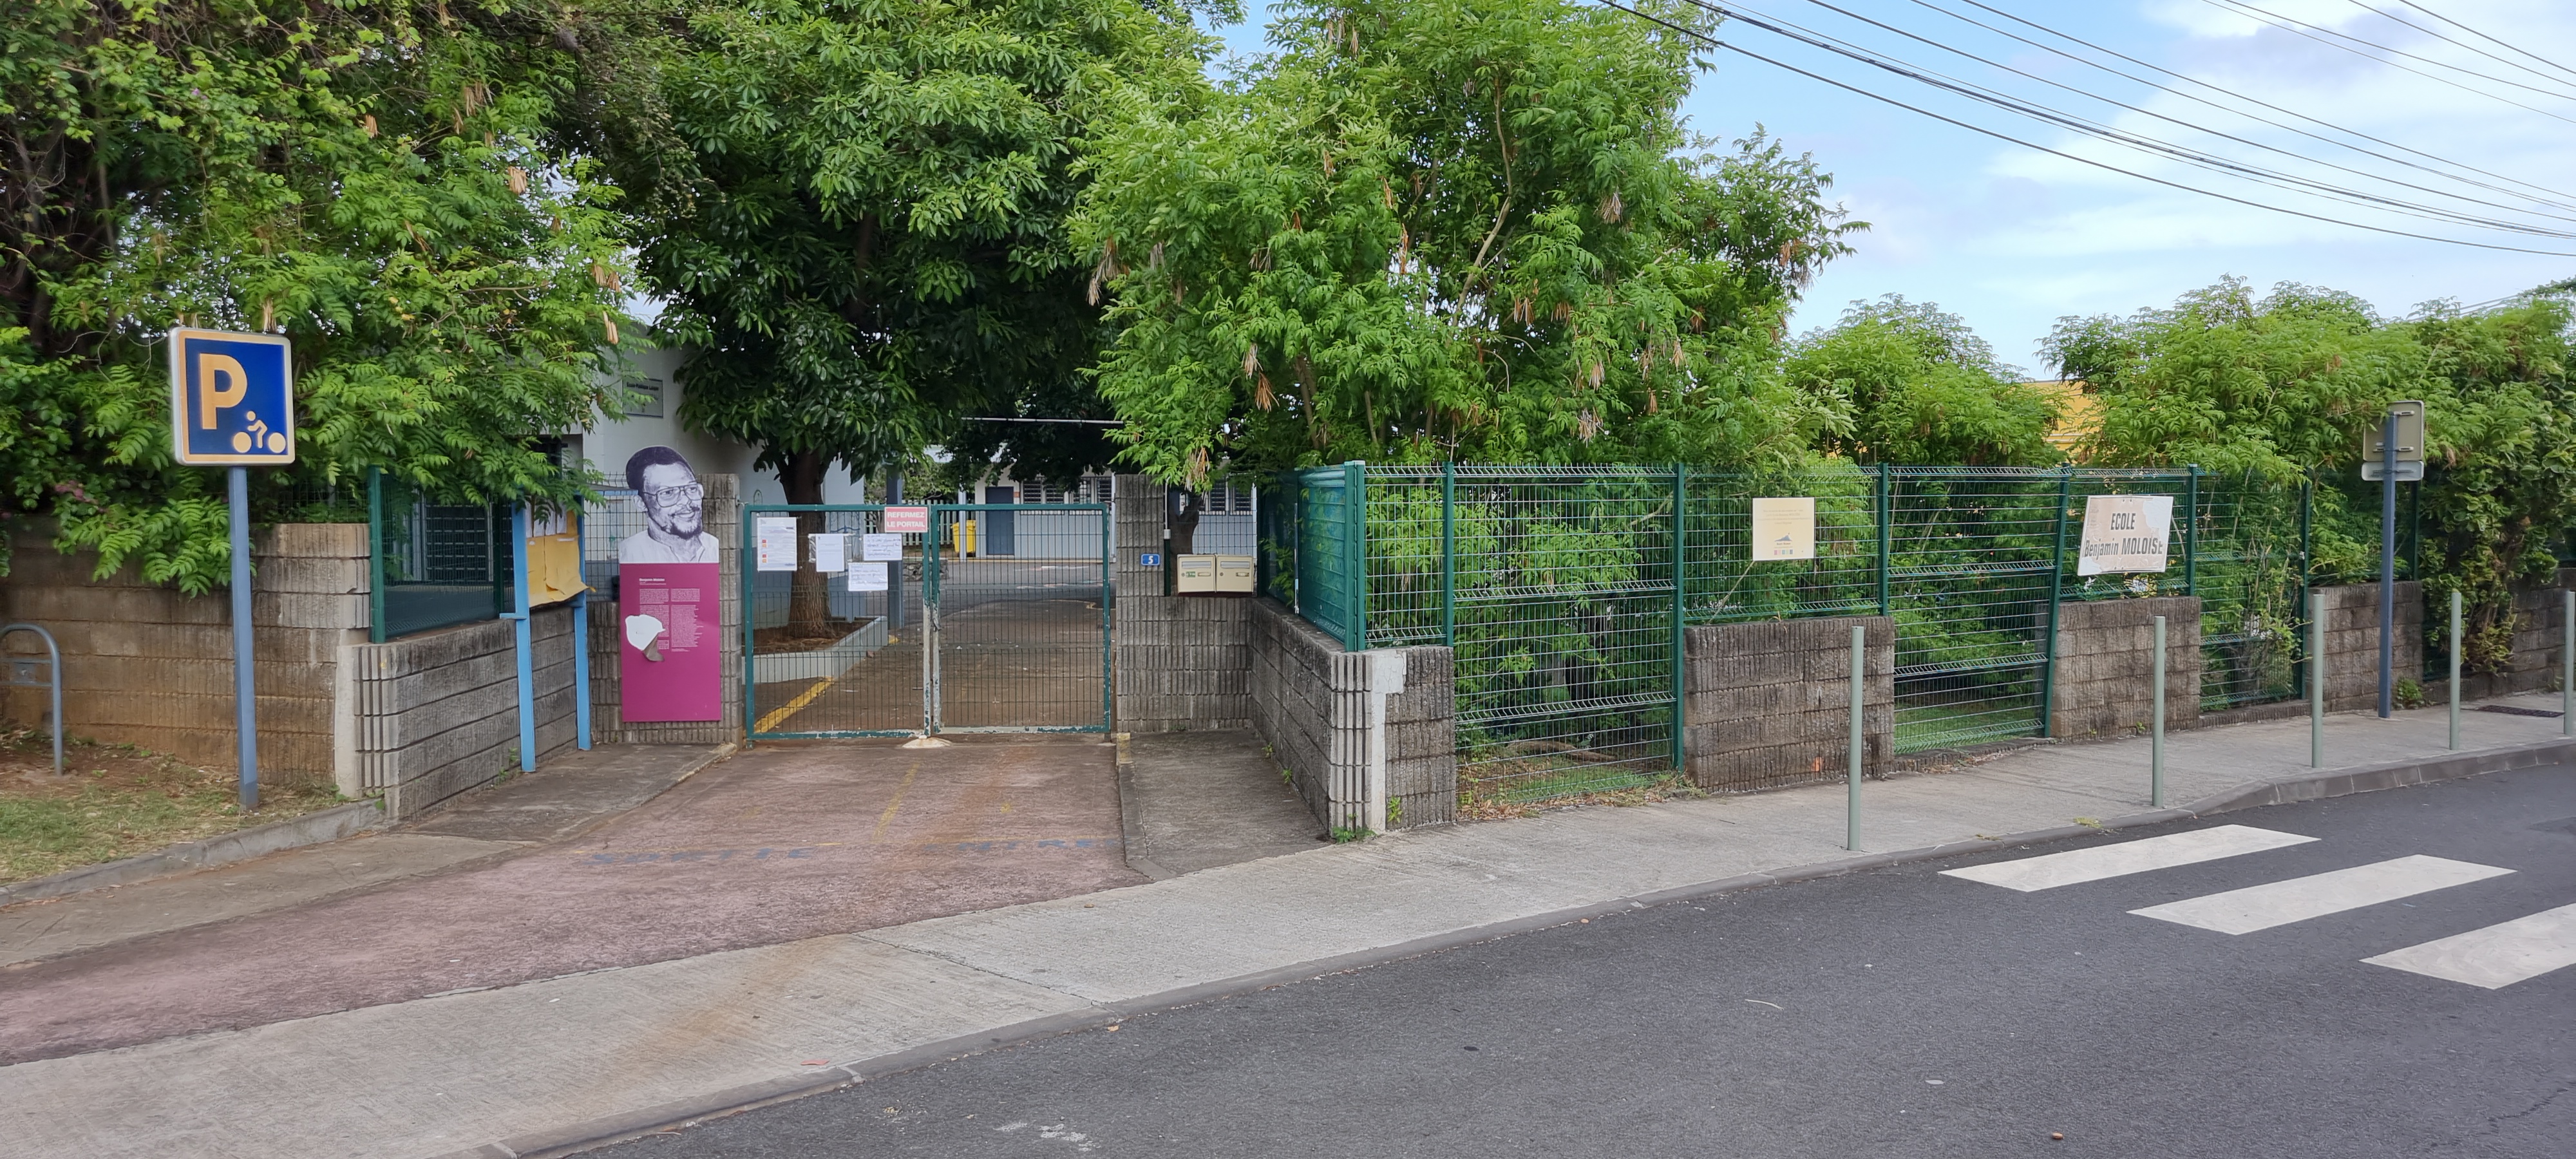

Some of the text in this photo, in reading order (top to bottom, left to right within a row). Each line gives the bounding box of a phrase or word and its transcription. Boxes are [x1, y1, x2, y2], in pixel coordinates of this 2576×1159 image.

[200, 353, 247, 429] P
[2110, 513, 2136, 530] ECOLE
[2085, 538, 2163, 560] Benjamin MOLOISE
[1148, 556, 1153, 564] 5
